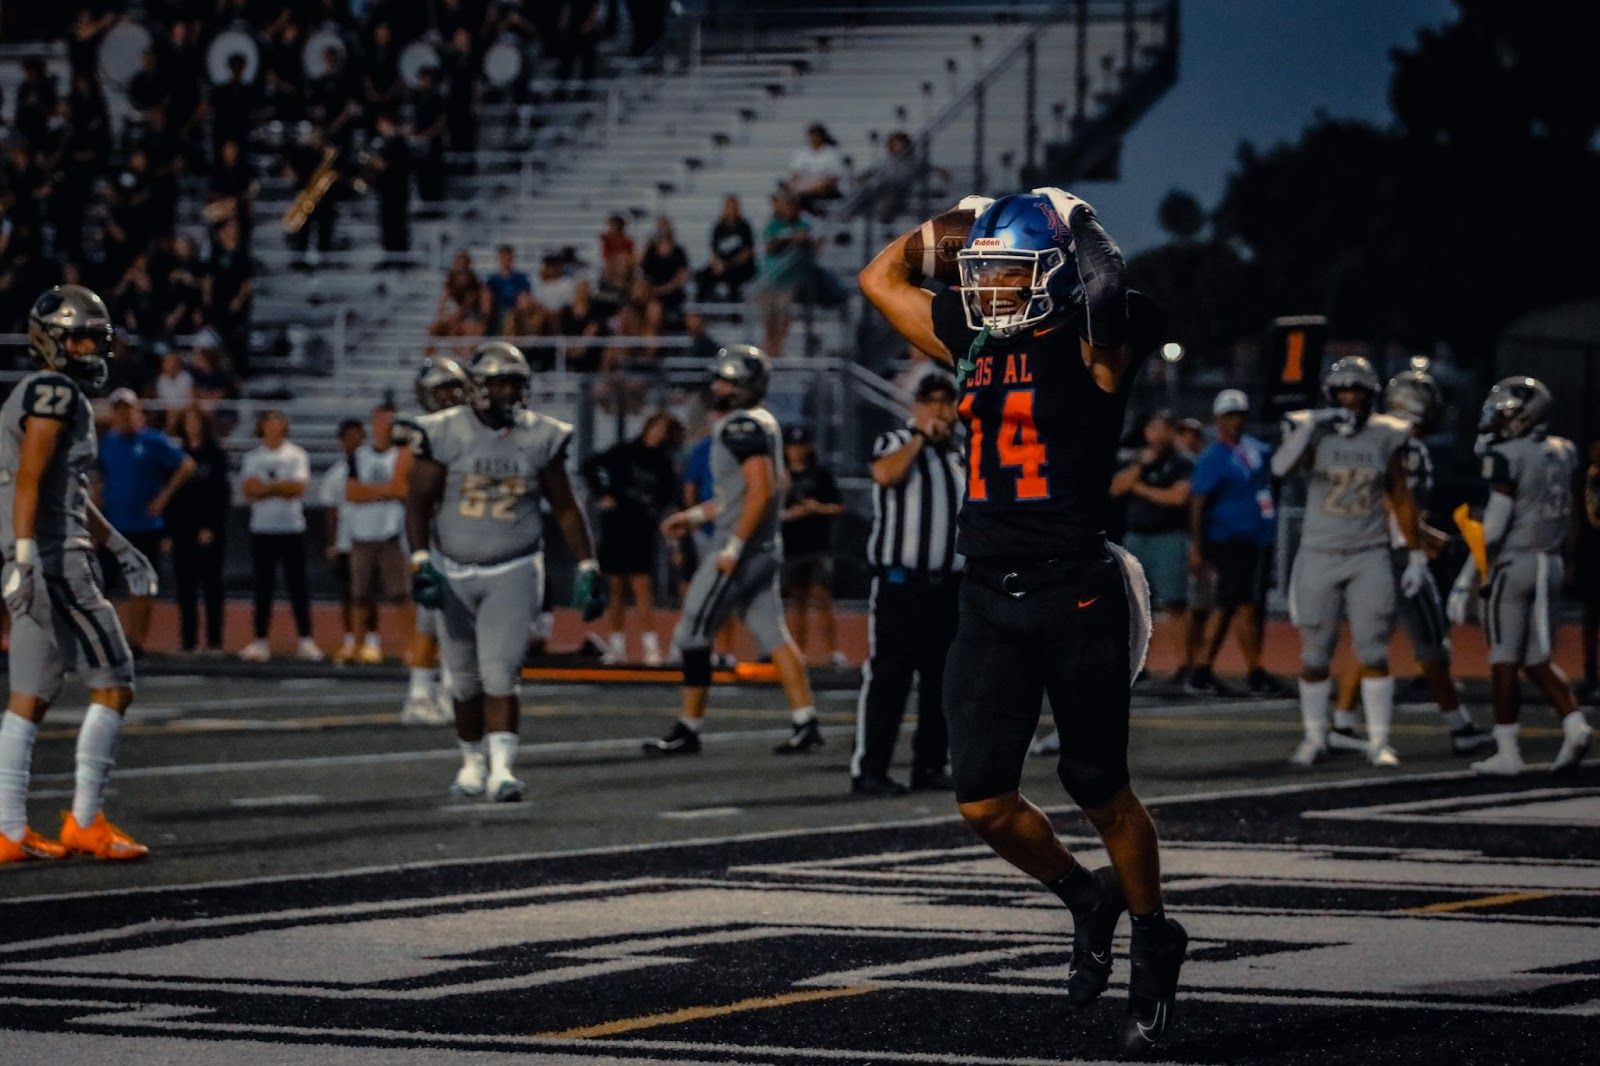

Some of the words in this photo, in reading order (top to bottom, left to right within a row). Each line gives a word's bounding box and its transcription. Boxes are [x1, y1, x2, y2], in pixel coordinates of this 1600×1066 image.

[1003, 353, 1034, 385] AL
[32, 383, 73, 416] 27
[957, 387, 1051, 502] 14
